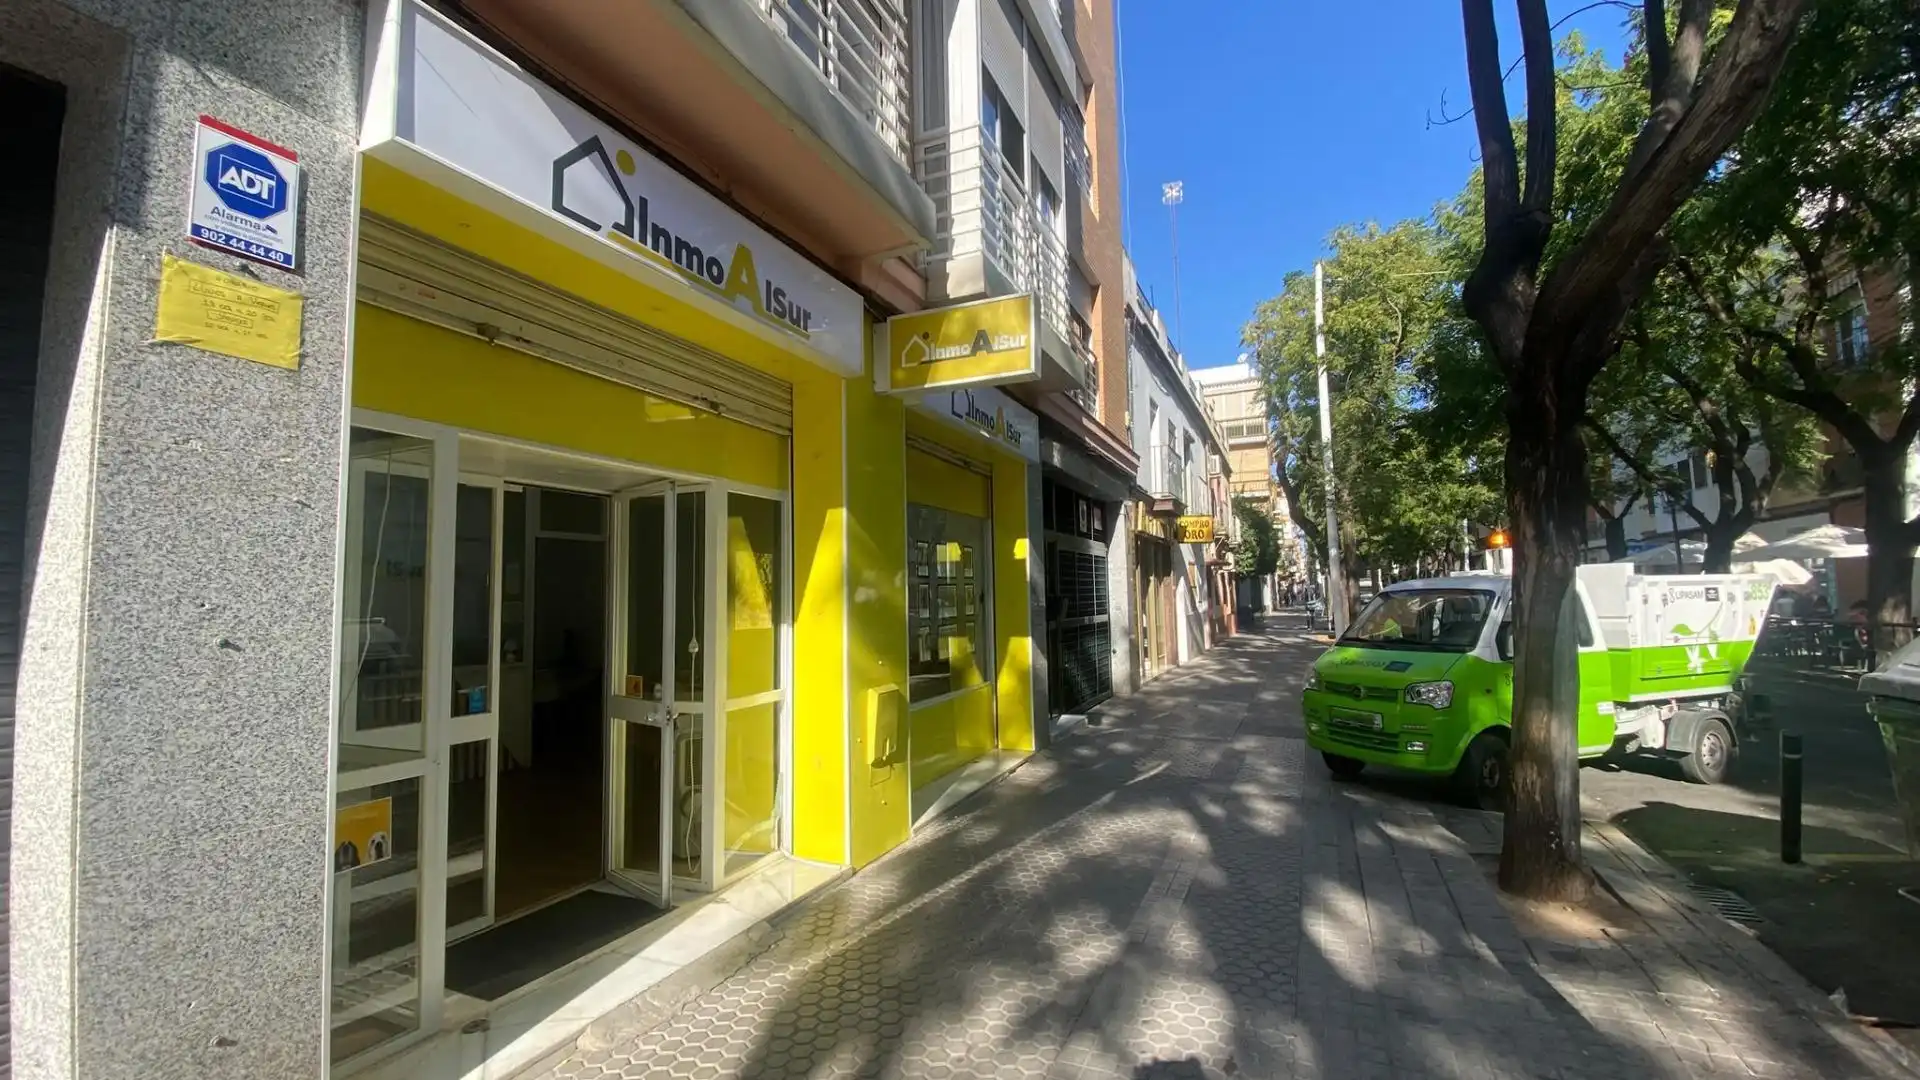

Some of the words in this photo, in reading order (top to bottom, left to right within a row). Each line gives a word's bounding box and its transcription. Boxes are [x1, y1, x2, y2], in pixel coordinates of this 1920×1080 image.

[219, 165, 276, 200] ADT
[210, 205, 261, 230] Alarma
[200, 227, 226, 244] 902
[229, 240, 246, 250] 44
[249, 244, 265, 256] 44
[268, 250, 284, 262] 40
[1180, 520, 1210, 528] COMPRO
[1185, 529, 1205, 540] ORO
